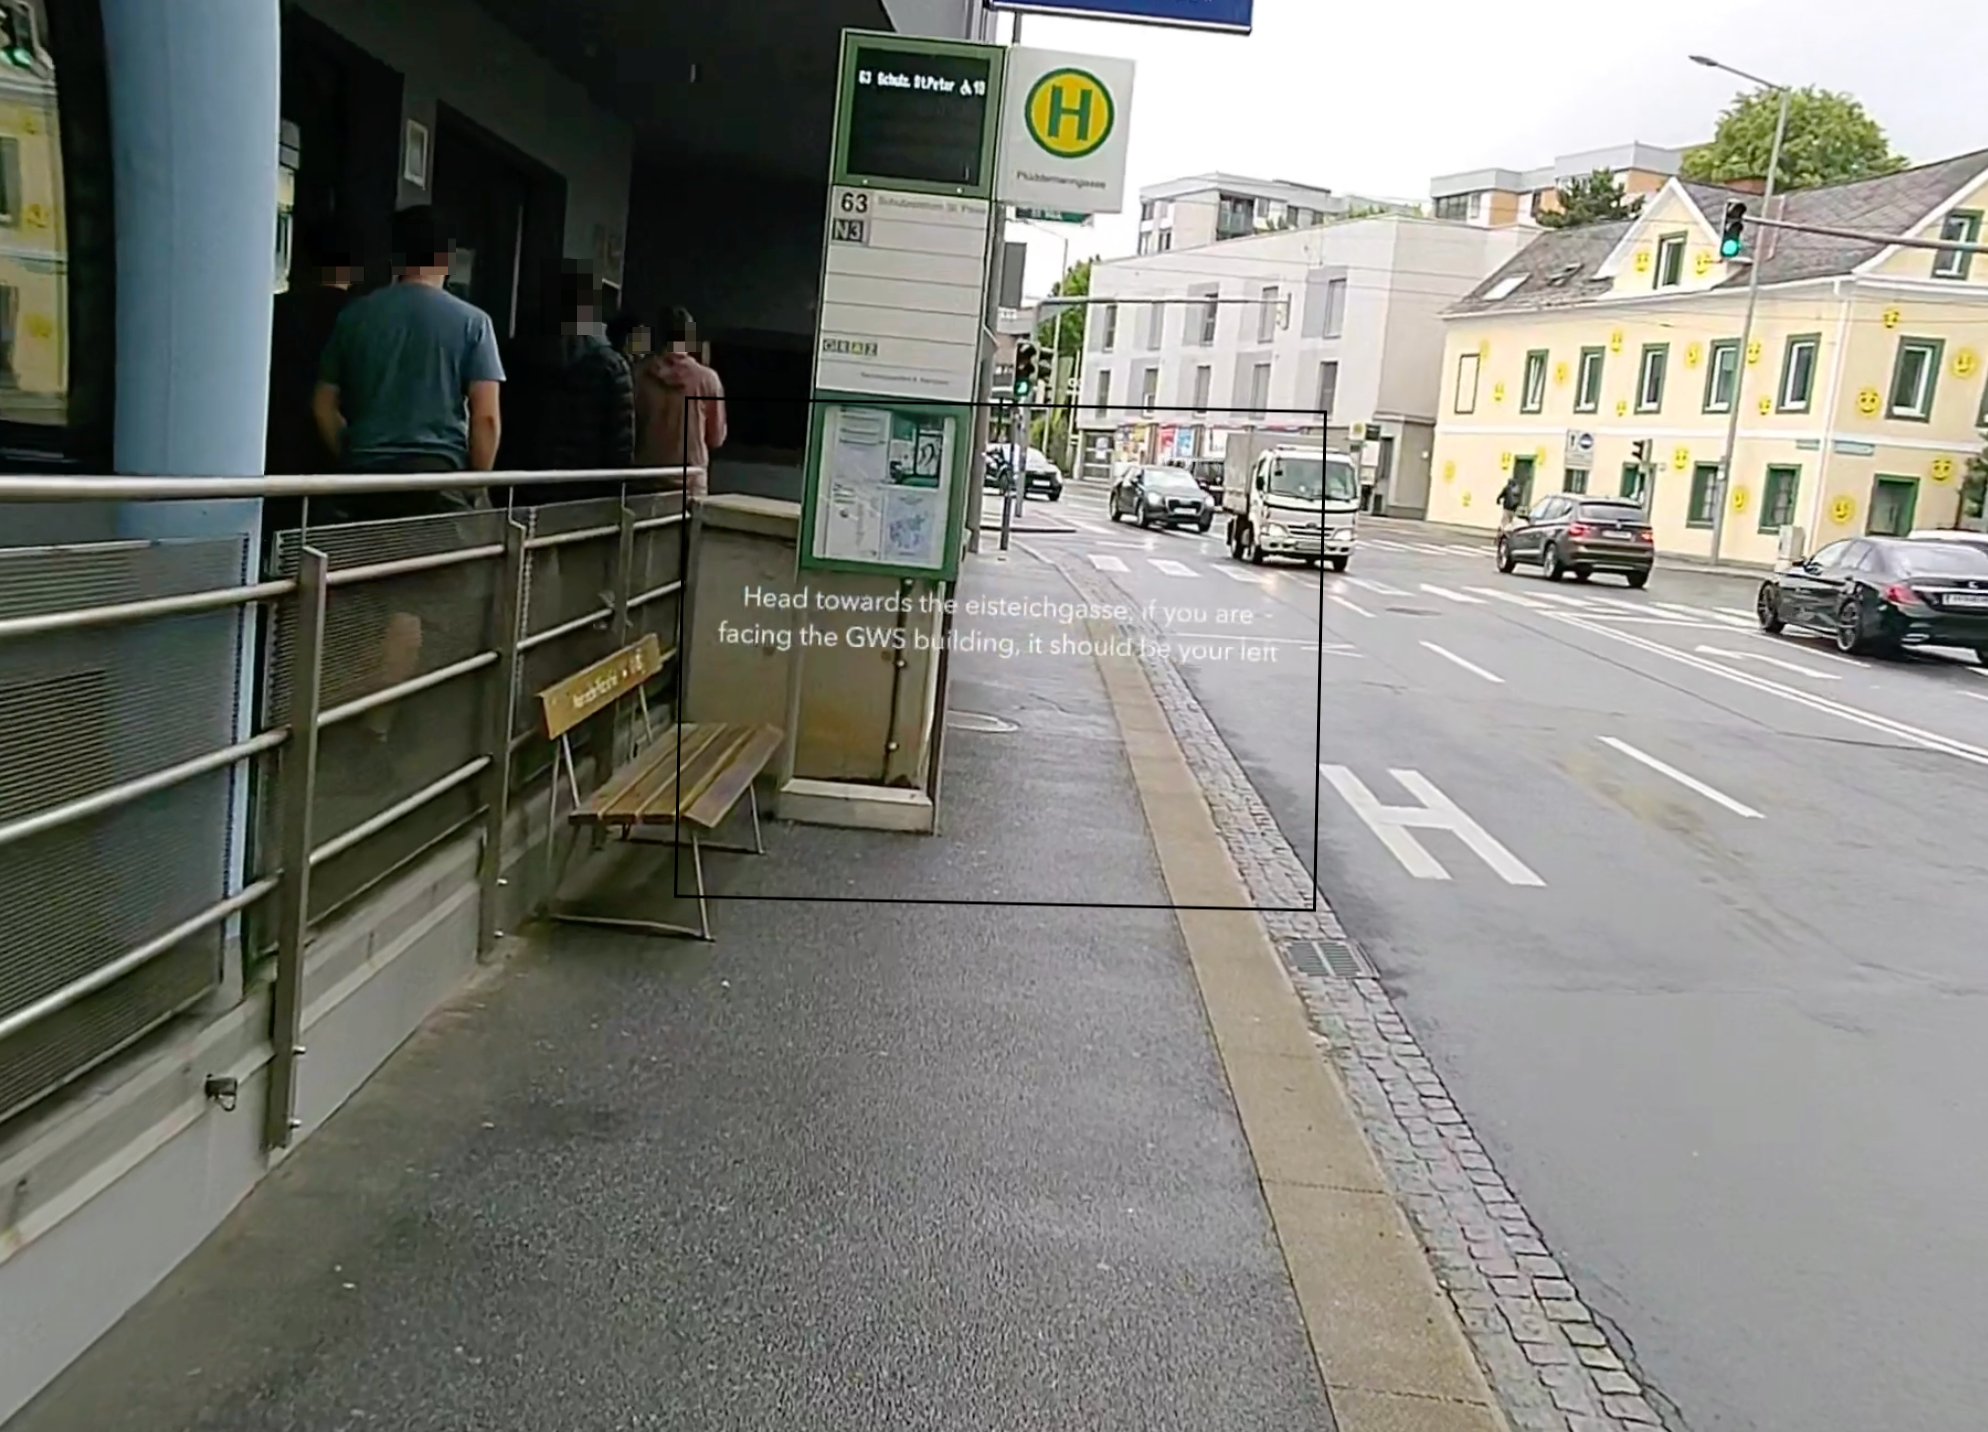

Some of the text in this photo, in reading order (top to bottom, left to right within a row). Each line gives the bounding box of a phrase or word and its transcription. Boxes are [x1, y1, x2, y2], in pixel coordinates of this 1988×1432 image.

[1048, 85, 1093, 141] H
[841, 192, 867, 213] 63
[834, 219, 863, 242] N3
[1319, 763, 1547, 887] H
